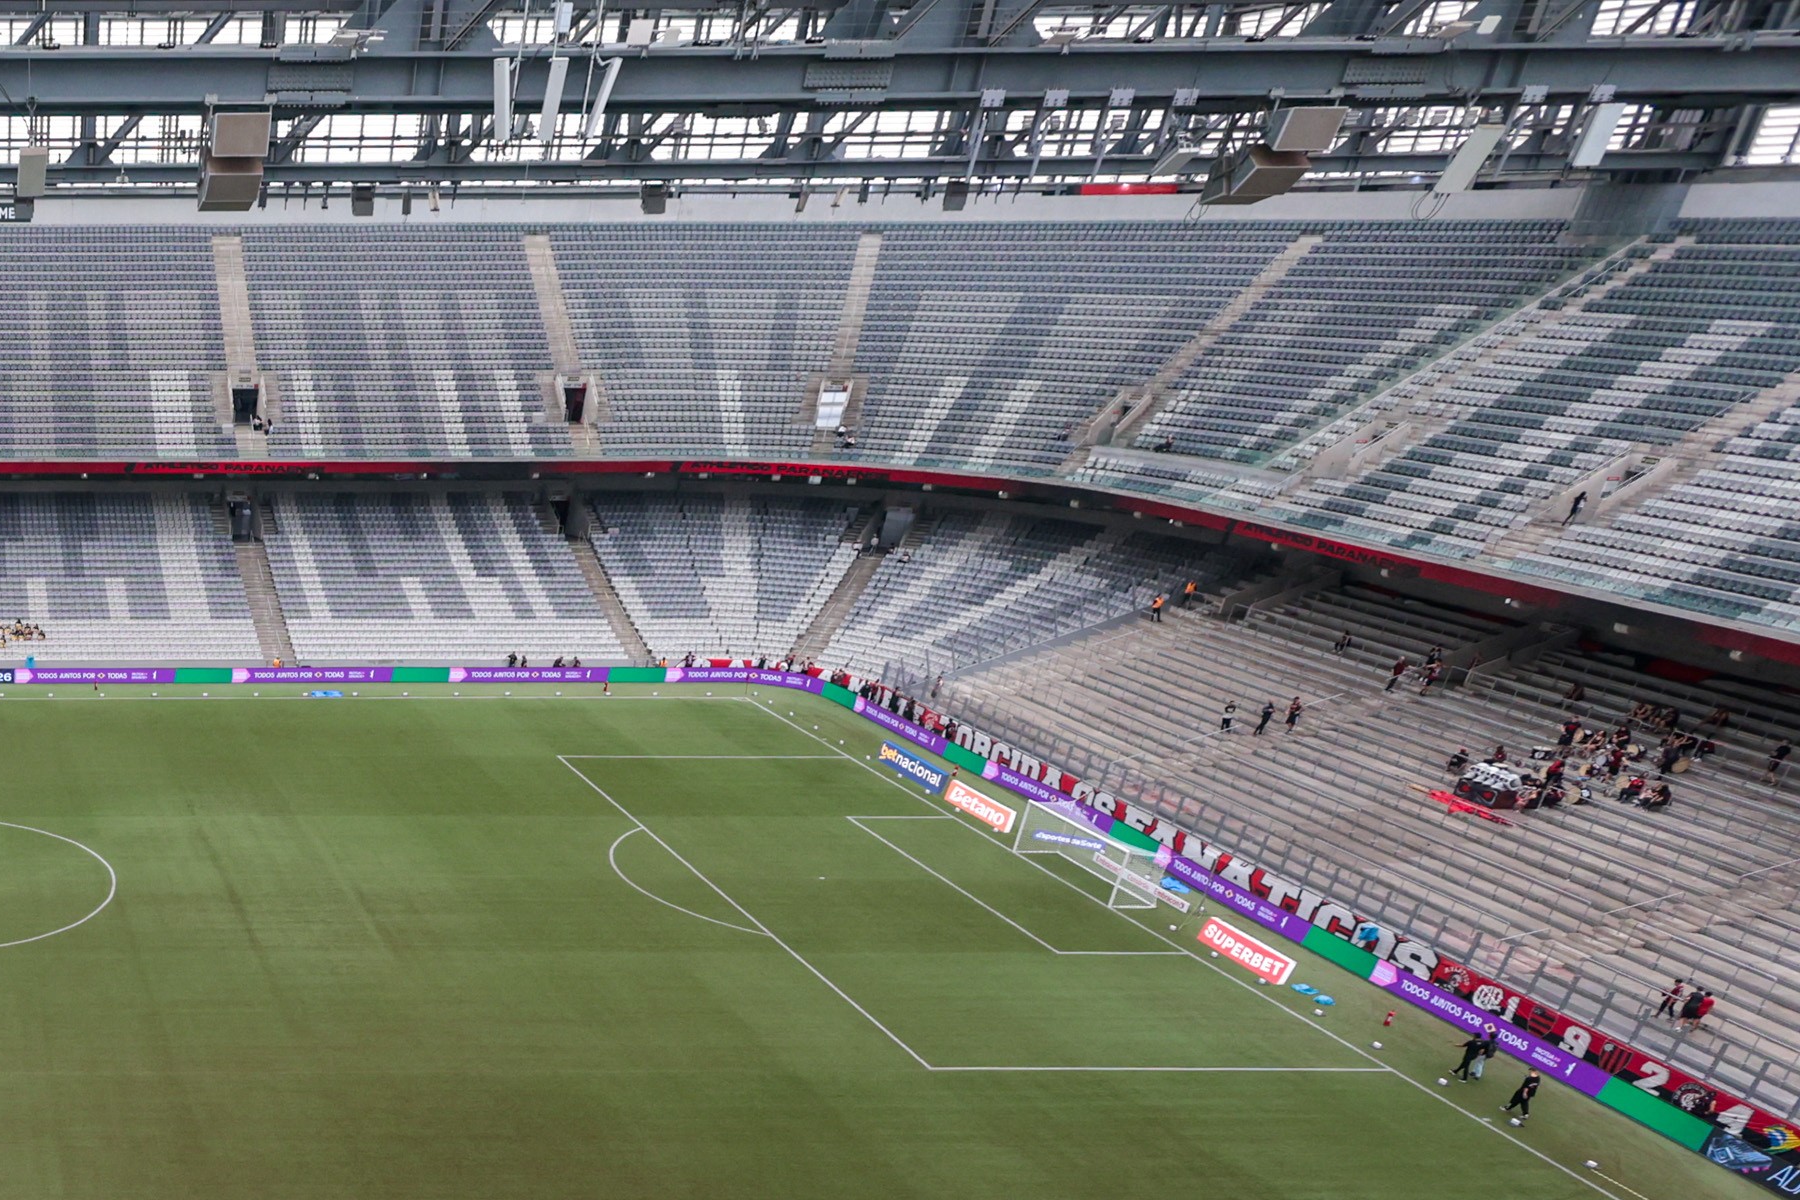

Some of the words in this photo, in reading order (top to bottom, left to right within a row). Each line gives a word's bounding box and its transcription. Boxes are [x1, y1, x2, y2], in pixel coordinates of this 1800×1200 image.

[880, 744, 942, 788] betnacional
[949, 787, 1005, 826] Betano
[1212, 881, 1224, 894] POR
[1234, 894, 1256, 911] TODAS
[1204, 923, 1284, 976] SUPERBET
[1401, 980, 1430, 1000] TODOS
[1430, 996, 1462, 1017] JUNTOS
[1462, 1011, 1482, 1027] POR
[1498, 1029, 1529, 1051] TODAS
